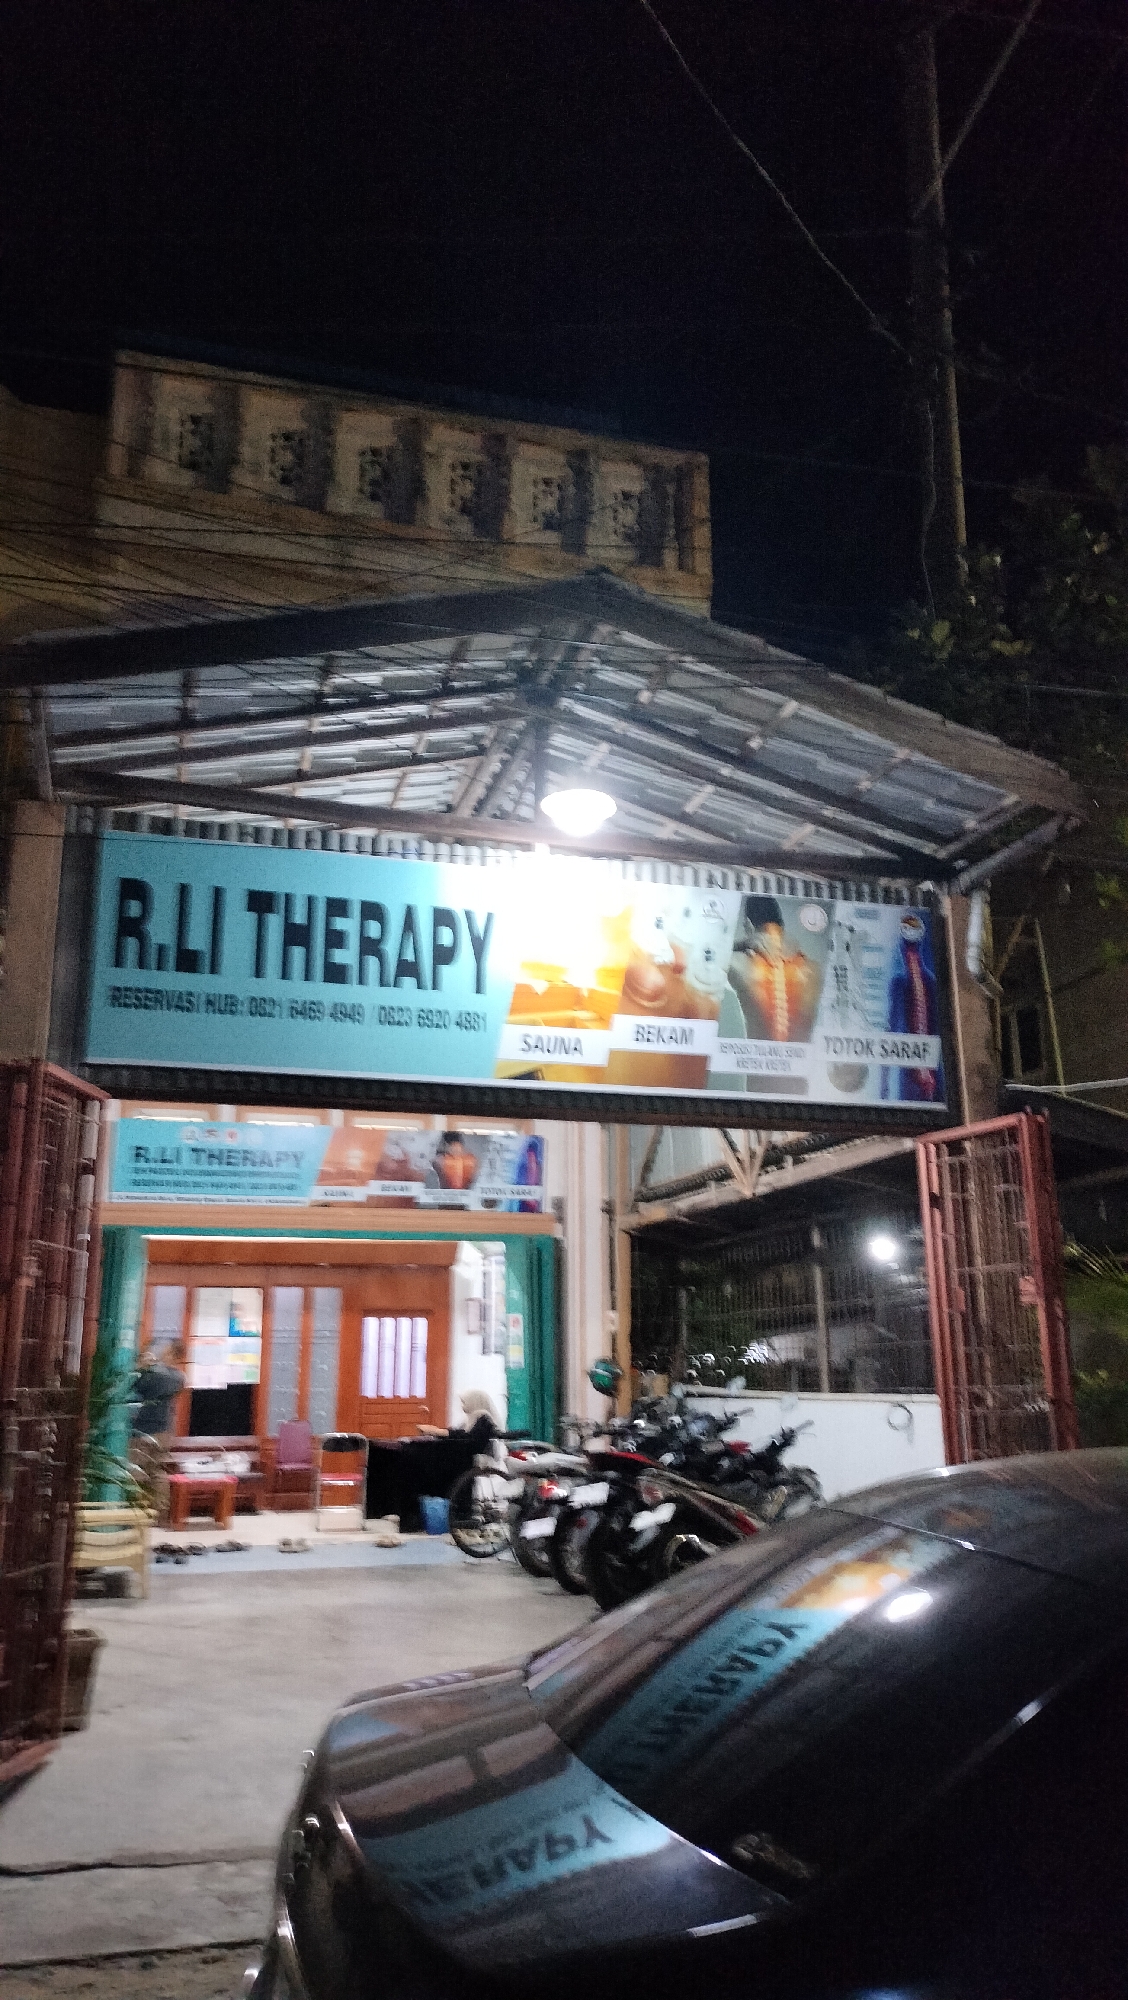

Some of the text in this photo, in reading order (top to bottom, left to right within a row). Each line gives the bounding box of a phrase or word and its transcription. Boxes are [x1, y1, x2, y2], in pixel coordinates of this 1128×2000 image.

[114, 877, 495, 995] R.LI THERAPY
[108, 985, 200, 1014] RESERVASI
[519, 1032, 584, 1057] SAUNA
[634, 1022, 695, 1047] BEKAM
[823, 1035, 876, 1059] TOTOK
[880, 1038, 930, 1063] SARAF
[191, 1147, 306, 1168] THERAPY
